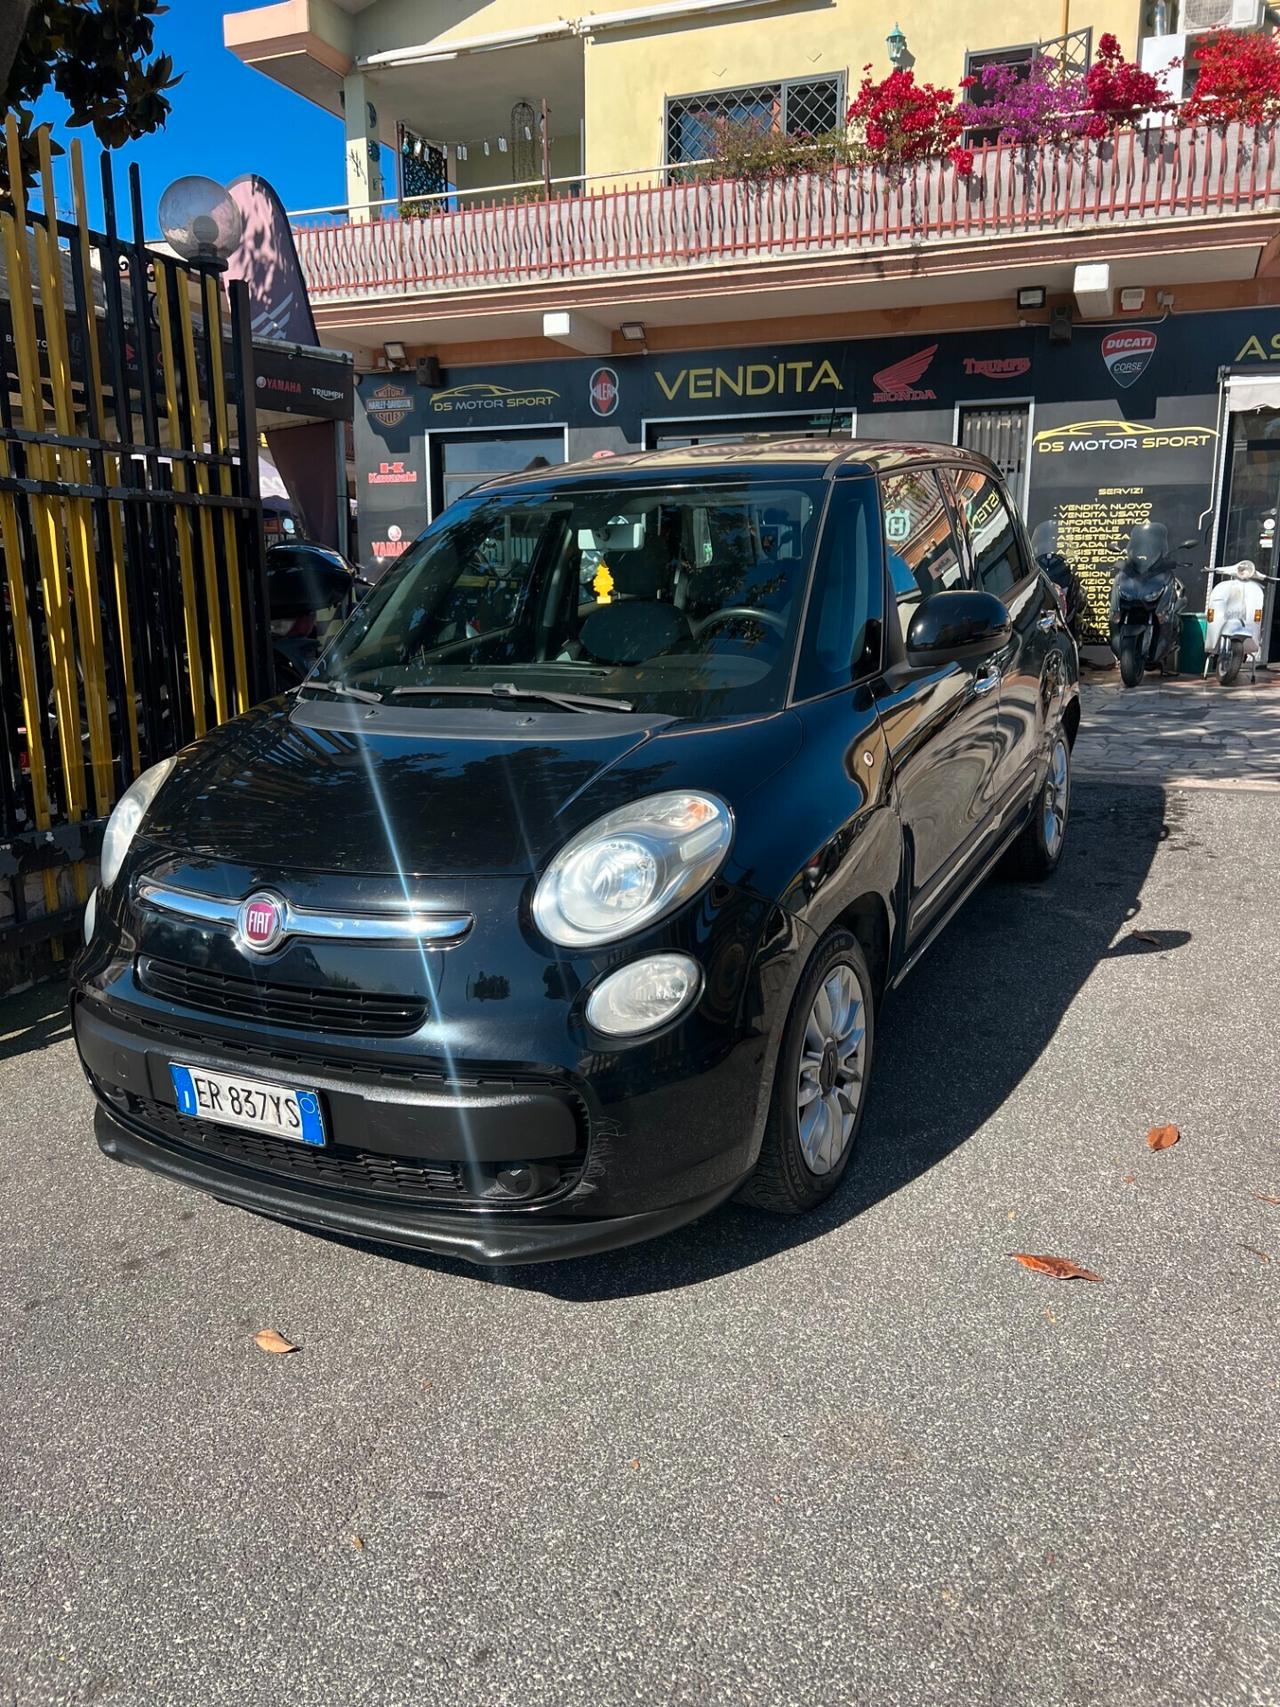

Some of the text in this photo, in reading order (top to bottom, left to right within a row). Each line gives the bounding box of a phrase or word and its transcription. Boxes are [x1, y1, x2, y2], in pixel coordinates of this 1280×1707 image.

[1106, 336, 1153, 350] DUCATI
[963, 356, 1031, 377] TRIUMPH
[1113, 360, 1143, 373] CORSE
[266, 376, 302, 394] YAMAHA
[654, 359, 845, 401] VENDITA
[311, 387, 344, 402] TRIUMPH
[872, 389, 937, 403] HONDA
[434, 395, 554, 412] DS MOTOR SPORT
[1038, 434, 1211, 453] DS MOTOR SPORT
[1098, 487, 1144, 496] SERVIZI
[1060, 502, 1153, 511] VENDITA NUOVO
[1059, 510, 1150, 519] VENDITA USATO
[1058, 518, 1151, 526] INFORTUNISTICA
[1057, 526, 1120, 534] STRADALE
[1057, 533, 1131, 541] ASSISTENZA
[371, 541, 412, 557] YAMAH
[1077, 563, 1096, 571] SKI
[248, 910, 273, 934] FIAT
[193, 1076, 301, 1128] ER 837YS
